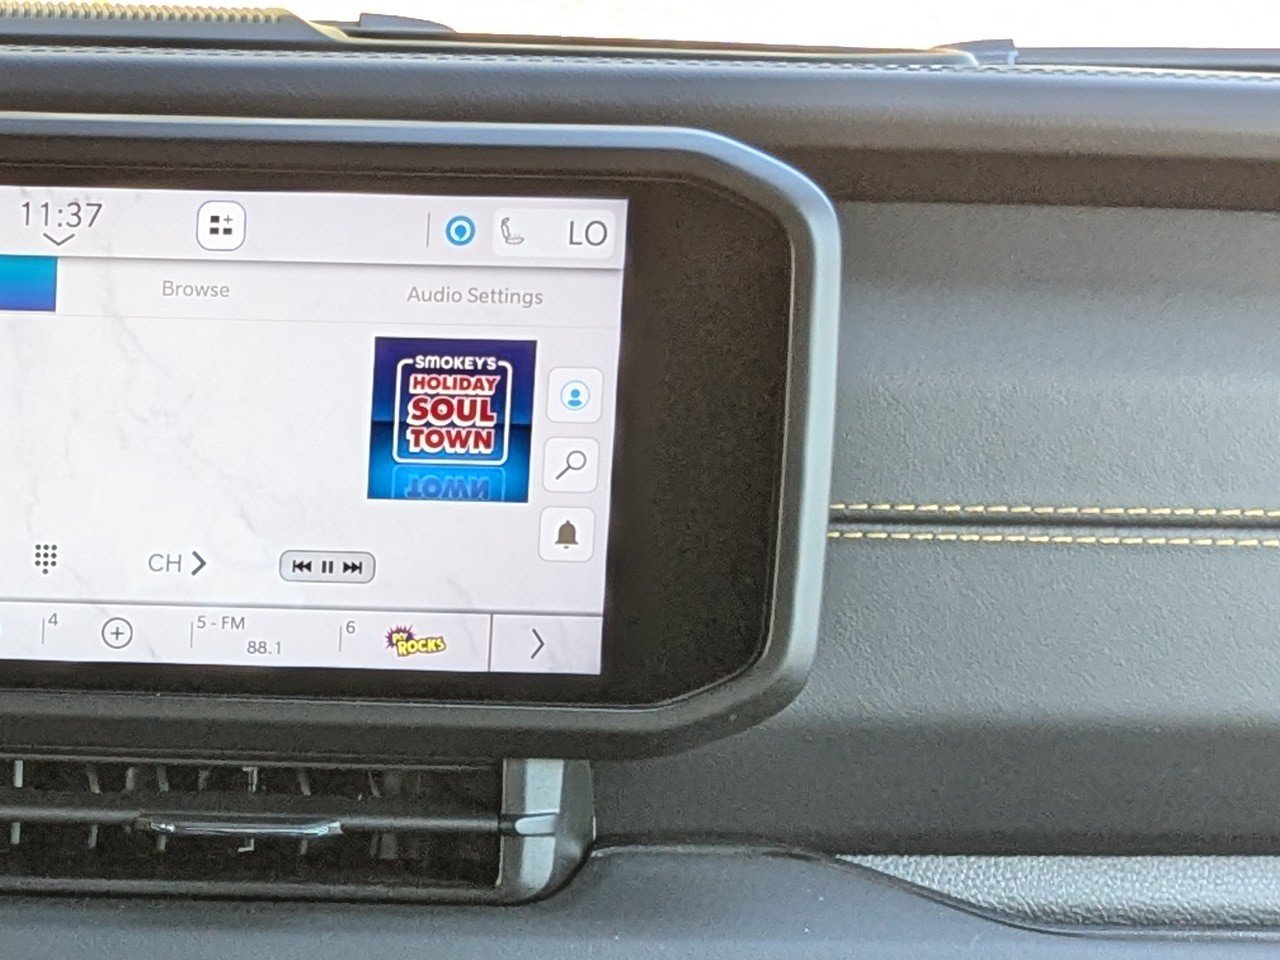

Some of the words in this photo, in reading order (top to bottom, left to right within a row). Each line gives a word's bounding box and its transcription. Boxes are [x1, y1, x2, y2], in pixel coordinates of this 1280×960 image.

[20, 202, 103, 228] 11:37
[568, 221, 608, 246] LO
[162, 280, 230, 299] Browse
[407, 287, 462, 305] Audio
[467, 288, 544, 309] Settings
[410, 375, 500, 393] HOLIDAY
[408, 396, 497, 425] SOUL
[407, 427, 495, 453] TOWN
[148, 554, 182, 573] CH
[48, 613, 58, 626] 4
[196, 617, 206, 630] 5
[221, 617, 246, 630] FM
[345, 621, 356, 634] 6
[246, 640, 282, 655] 88.1
[397, 637, 446, 656] ROCKS
